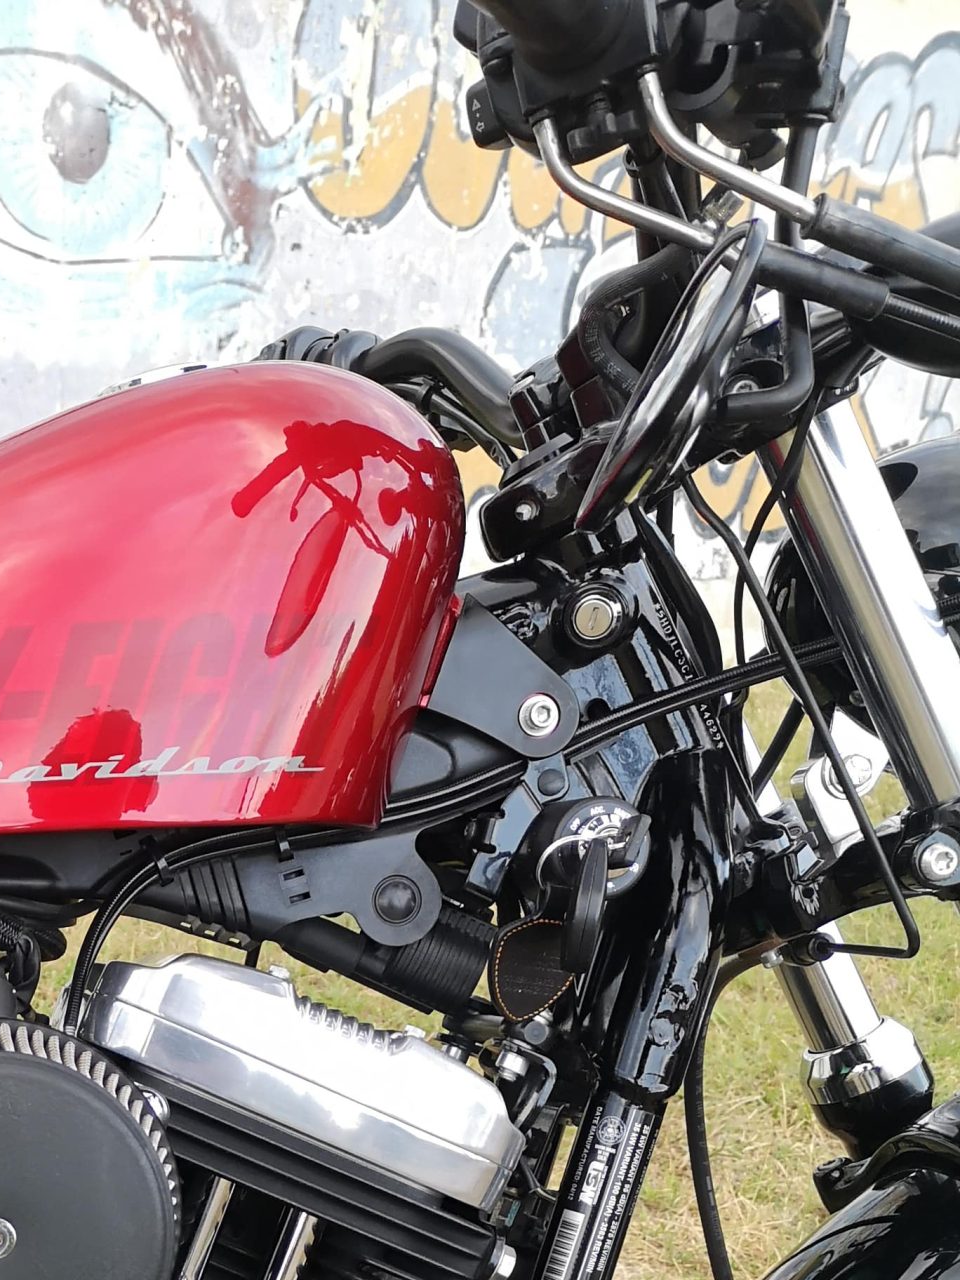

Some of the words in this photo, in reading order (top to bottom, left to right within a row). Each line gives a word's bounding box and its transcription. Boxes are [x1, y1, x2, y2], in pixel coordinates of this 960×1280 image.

[592, 1106, 602, 1124] DATE
[616, 1146, 633, 1180] VARIANT
[626, 1149, 643, 1183] VARIANT
[603, 1195, 616, 1217] dB(A)
[614, 1193, 626, 1215] dB(A)
[585, 1239, 601, 1273] REV/MIN
[596, 1238, 612, 1271] REV/MIN
